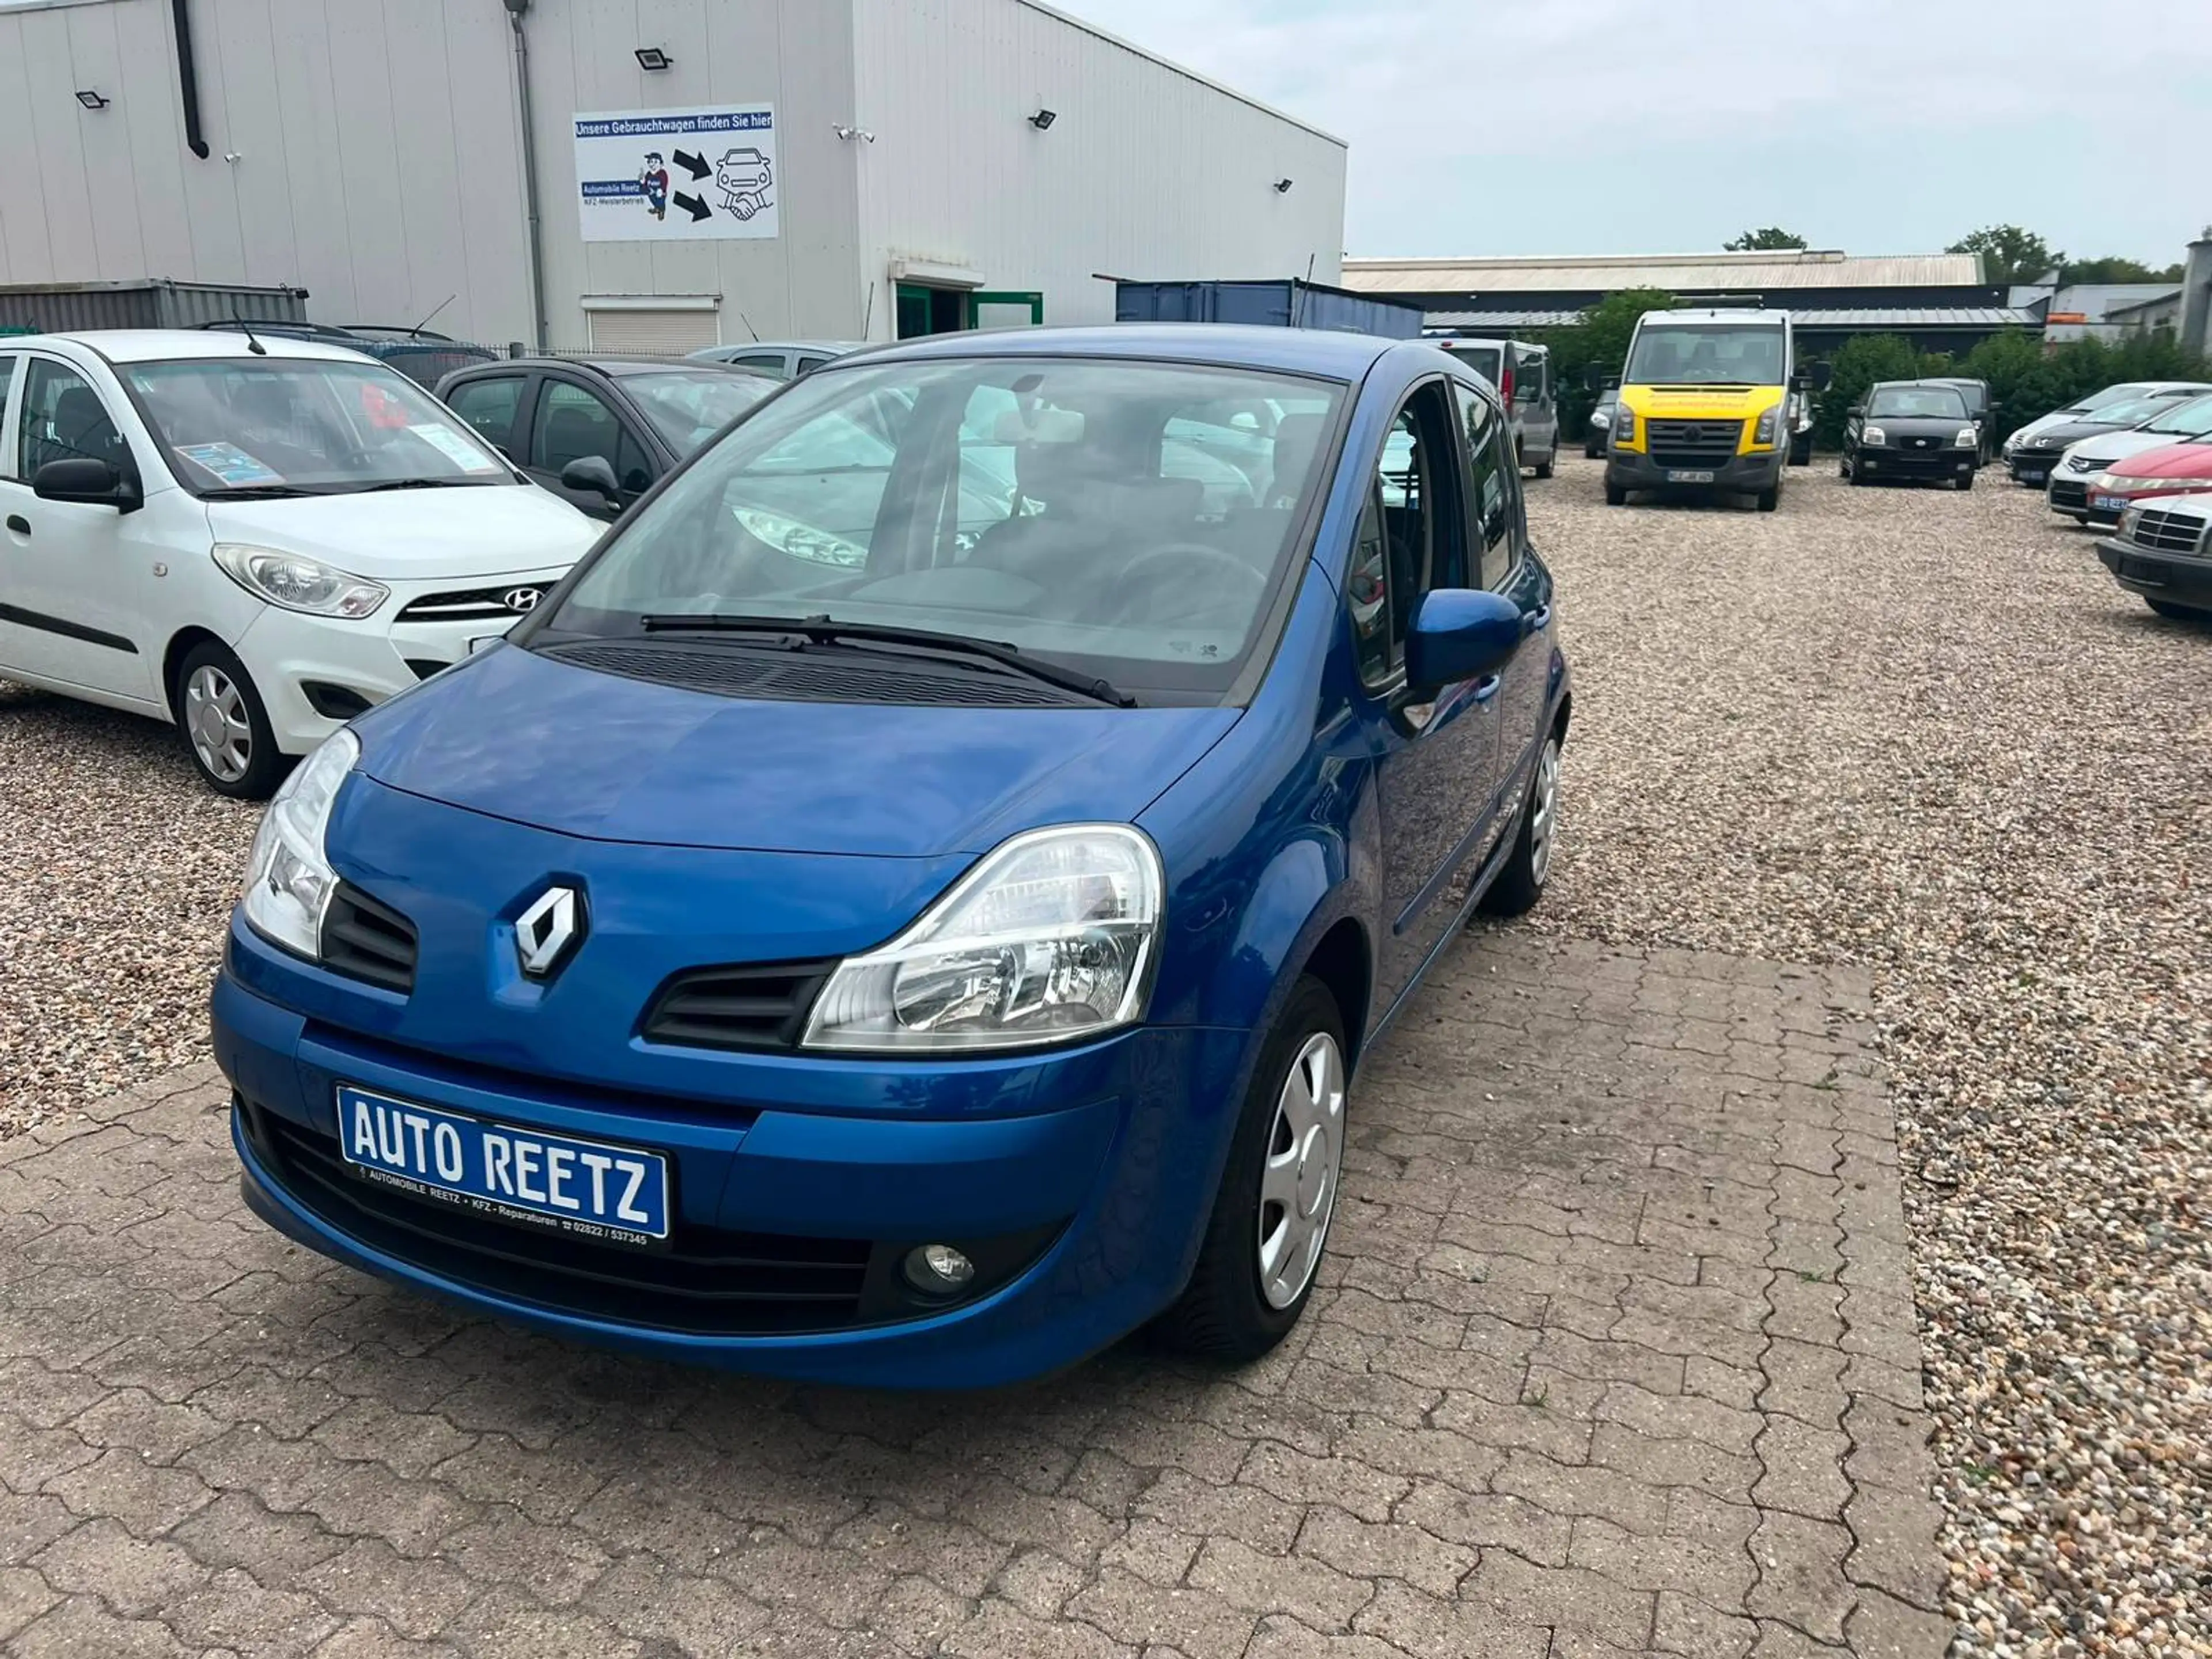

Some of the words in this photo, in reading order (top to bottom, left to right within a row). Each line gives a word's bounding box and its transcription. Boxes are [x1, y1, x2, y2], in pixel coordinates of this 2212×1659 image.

[576, 123, 609, 135] Unsere
[612, 118, 695, 134] Gebrauchtwagen
[698, 116, 730, 130] finden
[732, 115, 749, 127] Sie
[752, 113, 771, 126] hier
[354, 1101, 463, 1182] AUTO
[483, 1133, 648, 1224] REETZ
[369, 1170, 426, 1194] AUTOMOBILE
[430, 1187, 460, 1204] REETZ
[574, 1221, 604, 1237] 02822
[611, 1230, 647, 1246] 537345
